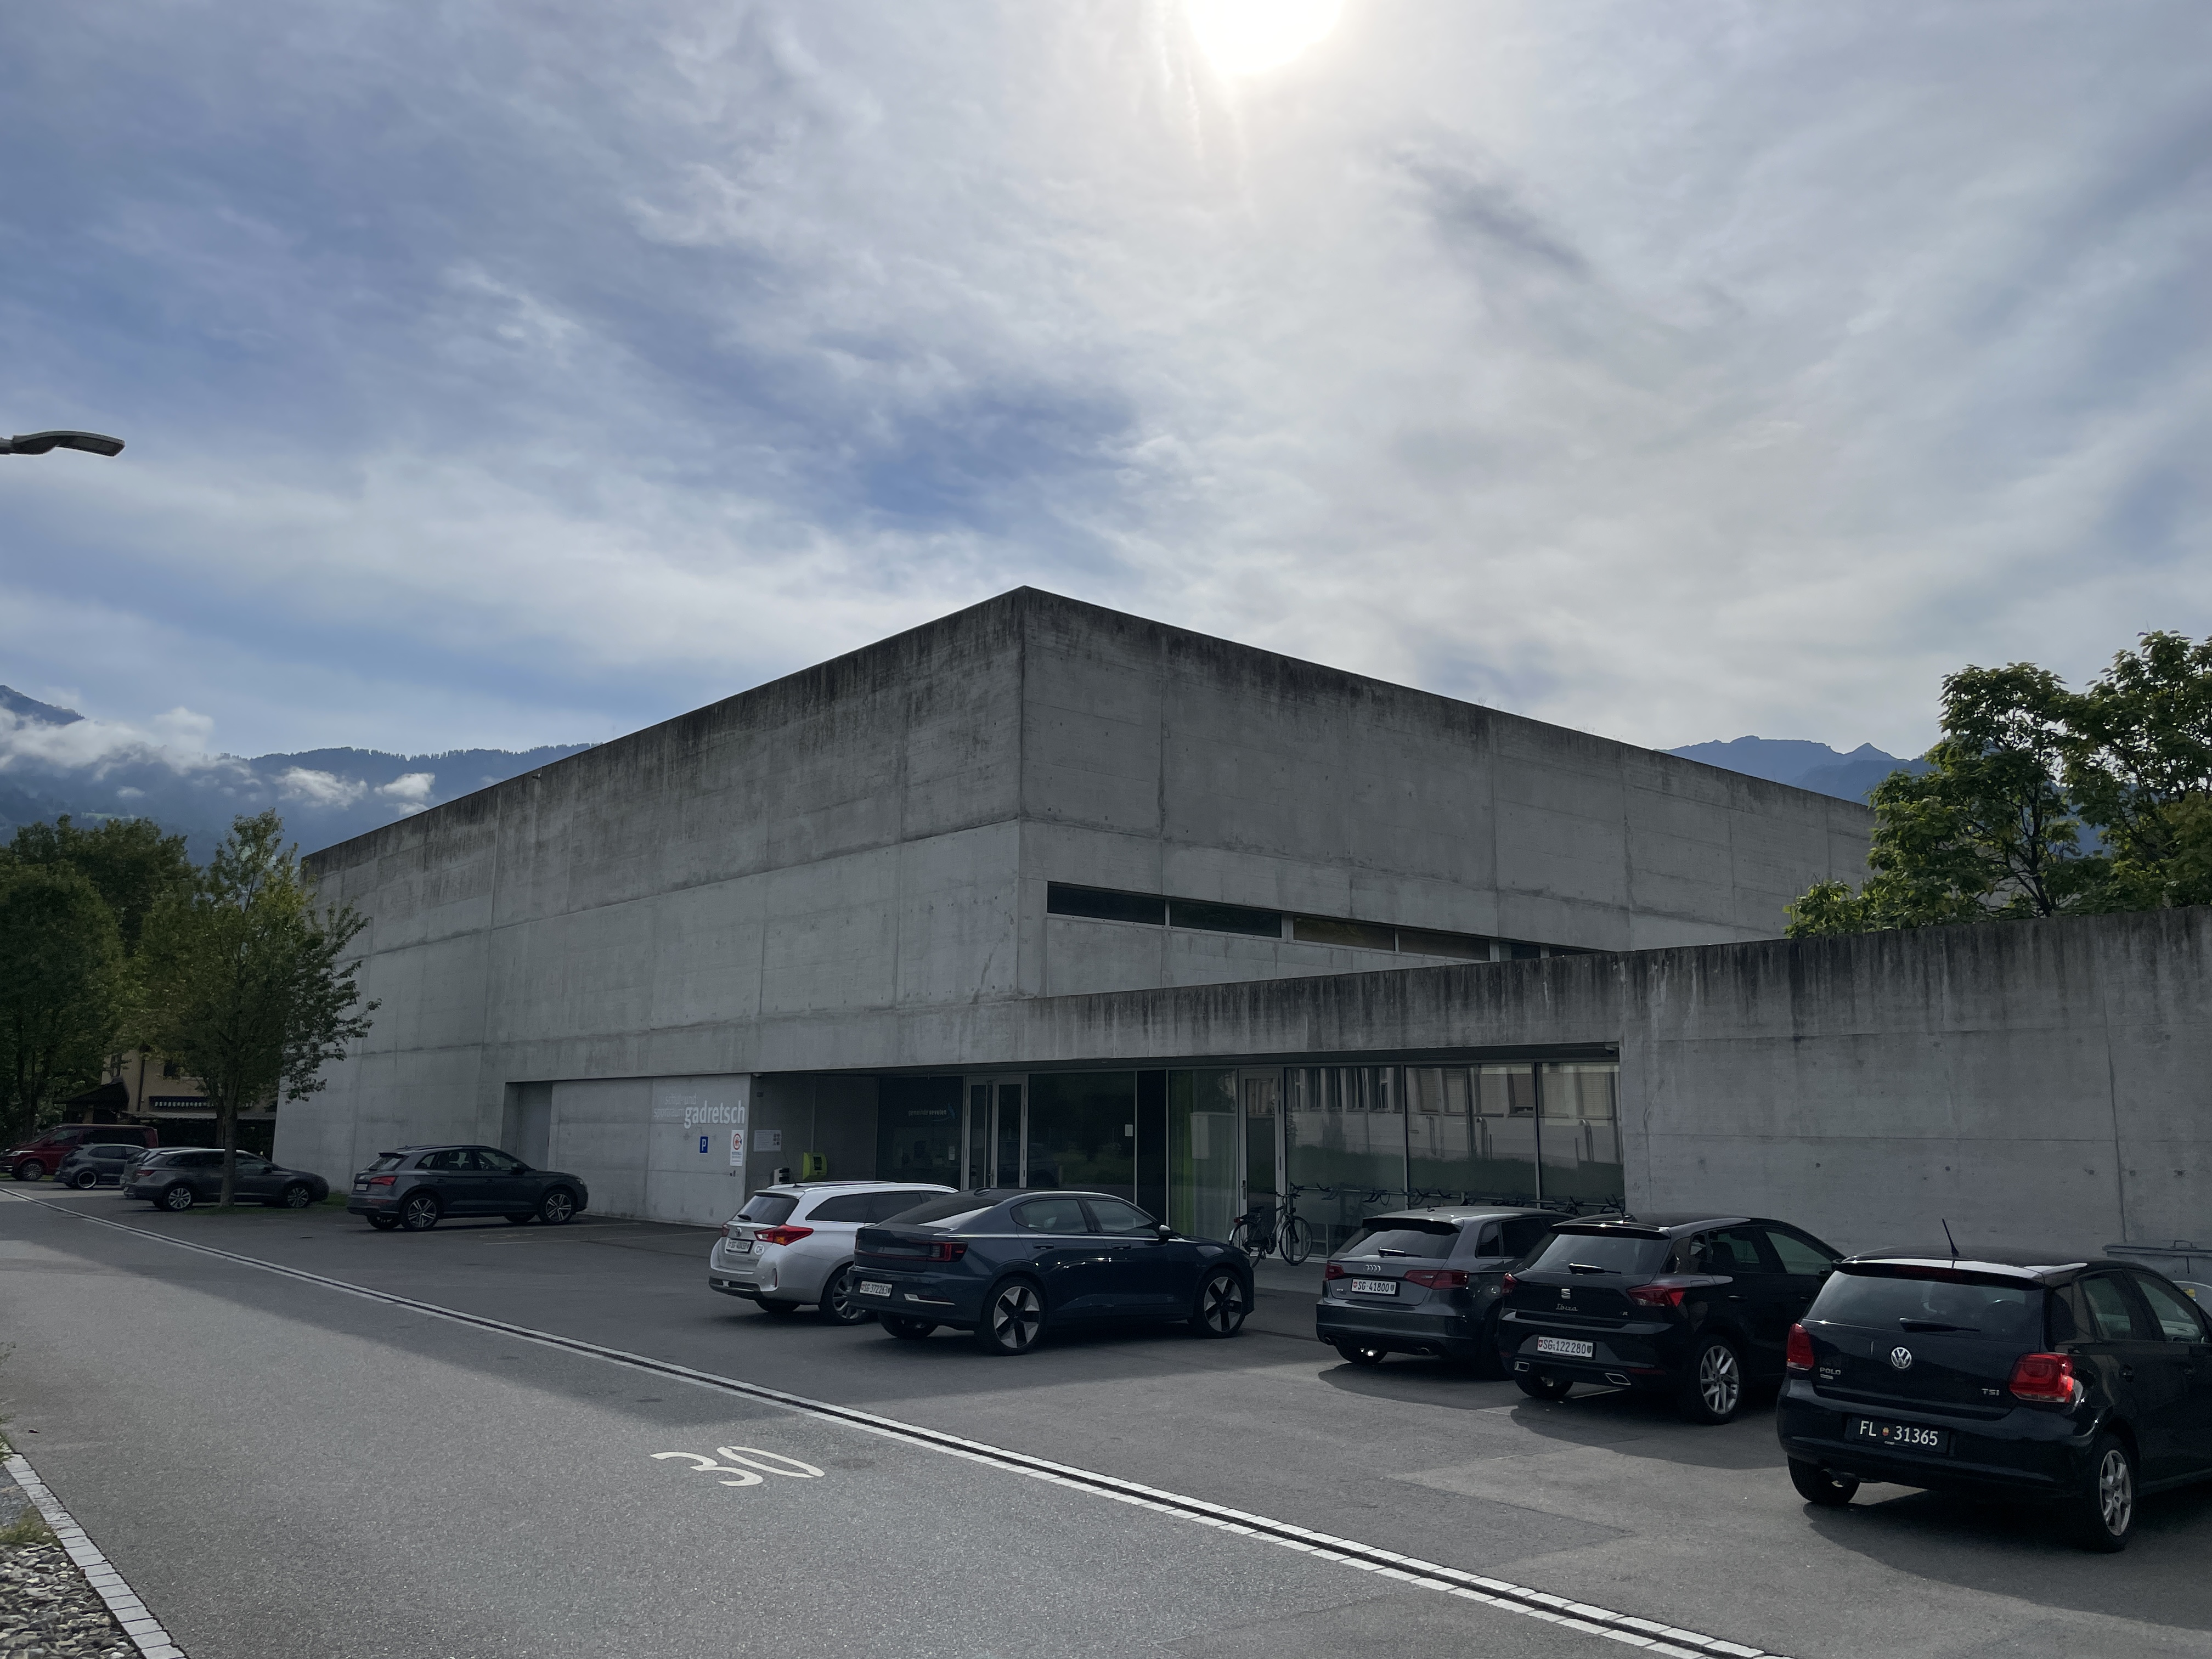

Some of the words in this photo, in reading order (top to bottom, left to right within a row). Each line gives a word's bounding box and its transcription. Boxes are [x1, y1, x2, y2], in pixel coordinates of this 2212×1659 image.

[684, 1100, 745, 1129] gadretsch
[701, 1138, 707, 1152] P
[756, 1245, 763, 1254] CH
[1358, 1281, 1366, 1290] SG
[1369, 1282, 1389, 1292] 41800
[1543, 1339, 1553, 1350] SG
[1981, 1388, 2000, 1396] TSI
[1860, 1420, 1877, 1437] FL
[1893, 1425, 1938, 1446] 31365
[650, 1446, 825, 1486] 30
